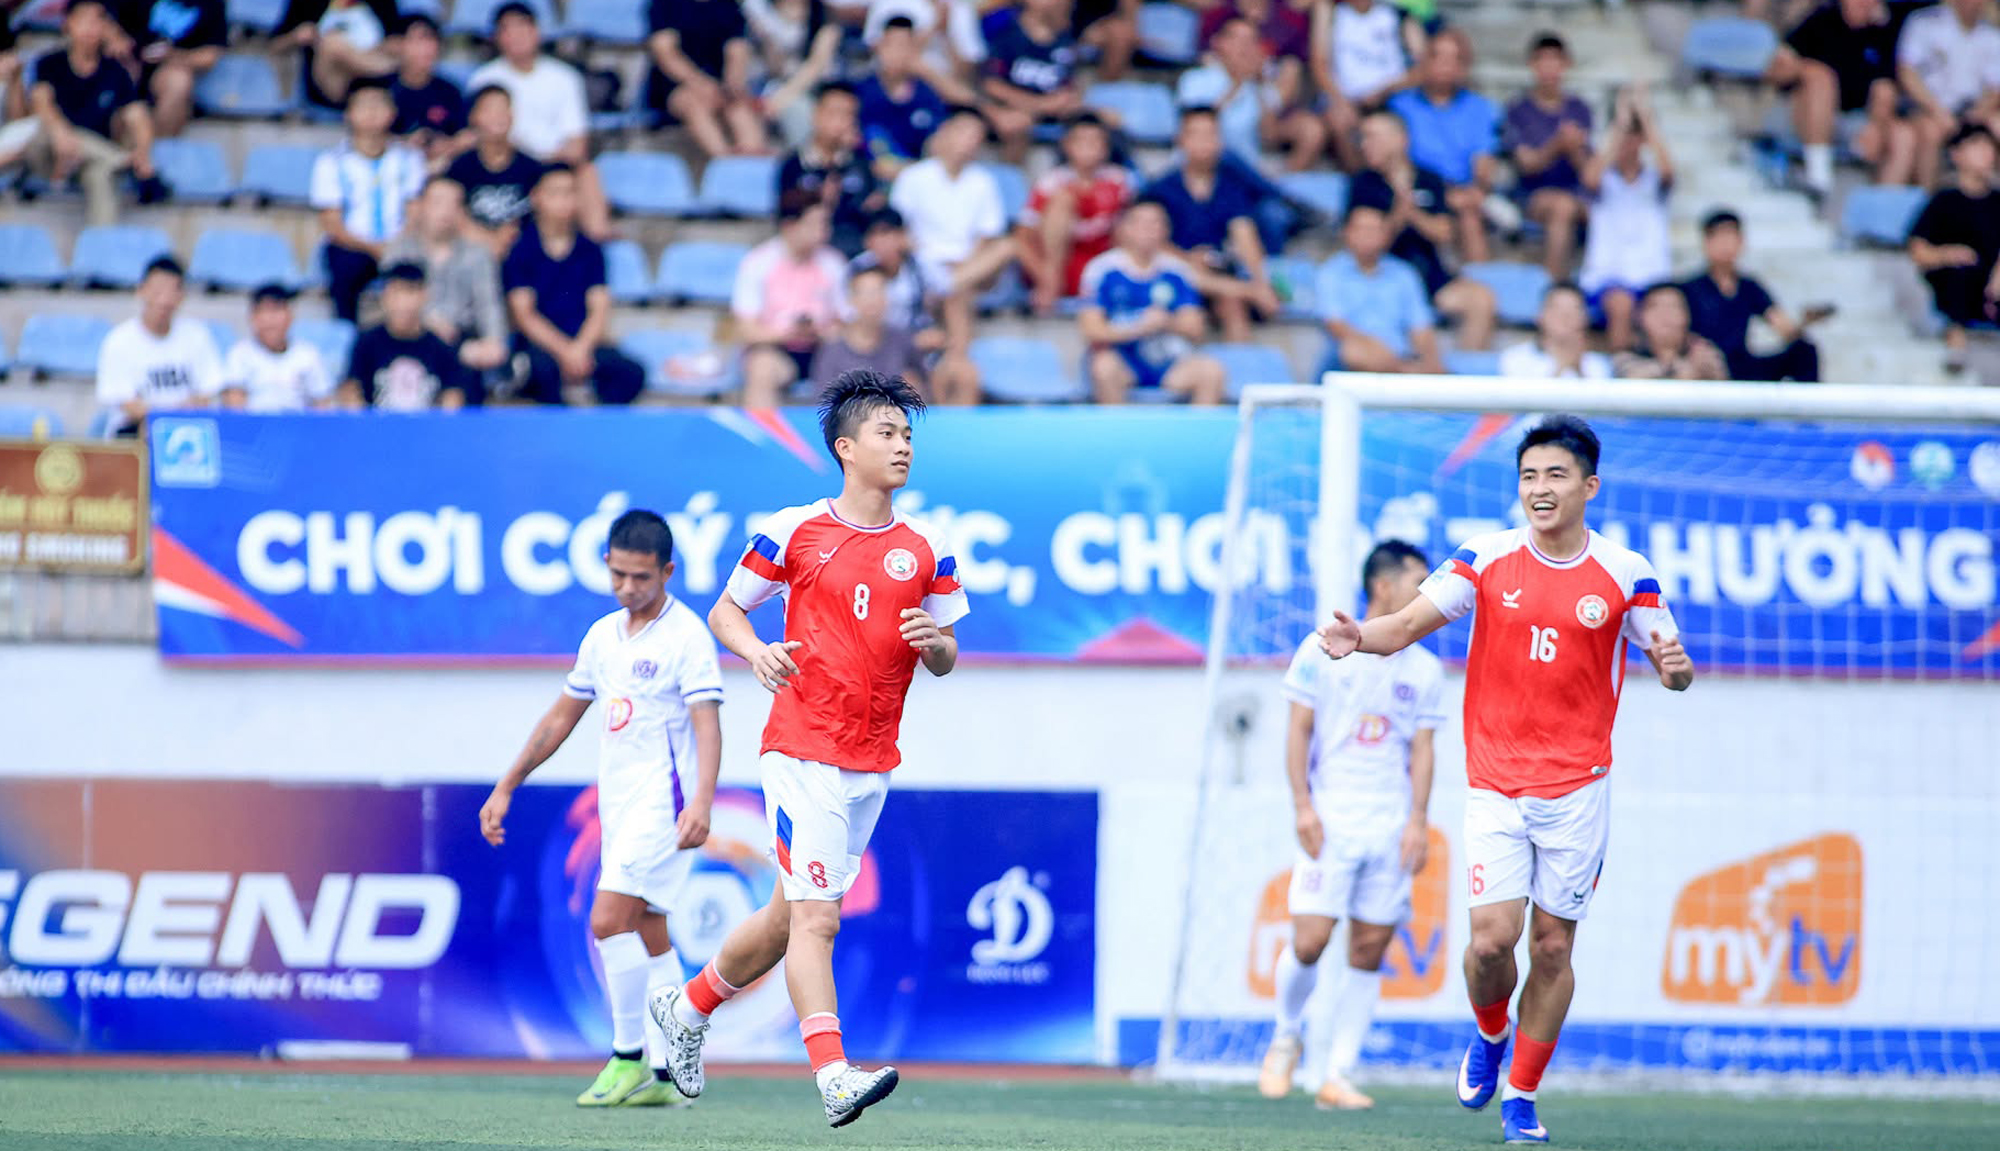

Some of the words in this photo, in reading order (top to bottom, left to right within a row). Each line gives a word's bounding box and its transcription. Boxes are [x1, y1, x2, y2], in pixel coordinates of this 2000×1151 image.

[237, 505, 484, 596] CHƠI
[665, 490, 733, 596] Ý
[1649, 502, 1995, 611] HƯỞNG
[853, 582, 871, 621] 8
[1529, 624, 1559, 663] 16
[807, 860, 828, 889] 8
[0, 868, 461, 969] GEND
[1670, 912, 1857, 1006] mytv
